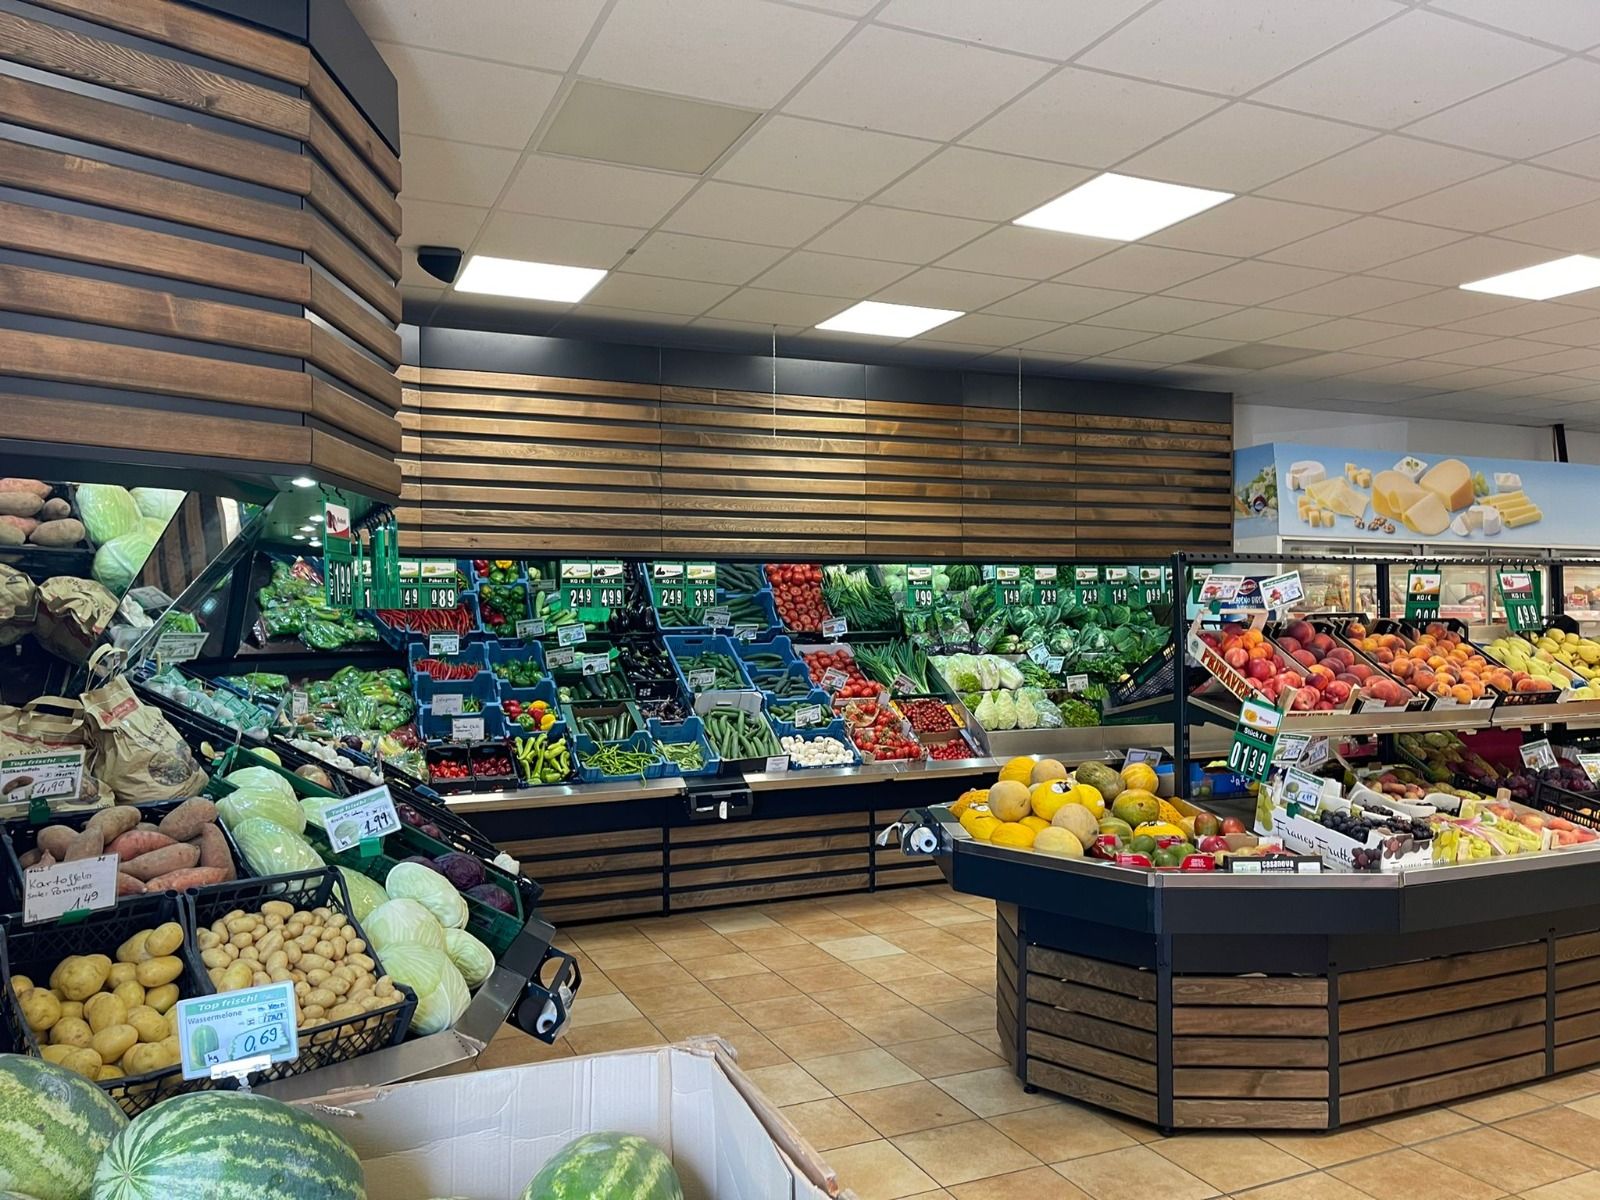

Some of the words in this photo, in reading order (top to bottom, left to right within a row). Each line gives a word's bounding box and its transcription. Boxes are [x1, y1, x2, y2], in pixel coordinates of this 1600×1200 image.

[431, 588, 455, 607] 089
[570, 588, 591, 607] 249
[601, 588, 622, 607] 499
[662, 589, 682, 607] 249
[695, 588, 715, 607] 399
[915, 589, 932, 606] 099
[1004, 589, 1020, 605] 149
[1040, 589, 1057, 605] 299
[1082, 588, 1098, 605] 249
[1112, 588, 1127, 605] 149
[1146, 588, 1161, 604] 099
[1517, 604, 1538, 629] 499
[1202, 649, 1256, 700] PRIMAVER
[1230, 741, 1267, 775] 0139
[364, 811, 389, 836] 1,99
[29, 871, 92, 890] Kartoffeln
[198, 1001, 219, 1011] Top
[221, 994, 258, 1006] frisch!
[187, 1010, 243, 1025] Wassermelone
[244, 1027, 277, 1052] 0,69
[208, 1054, 219, 1063] kg
